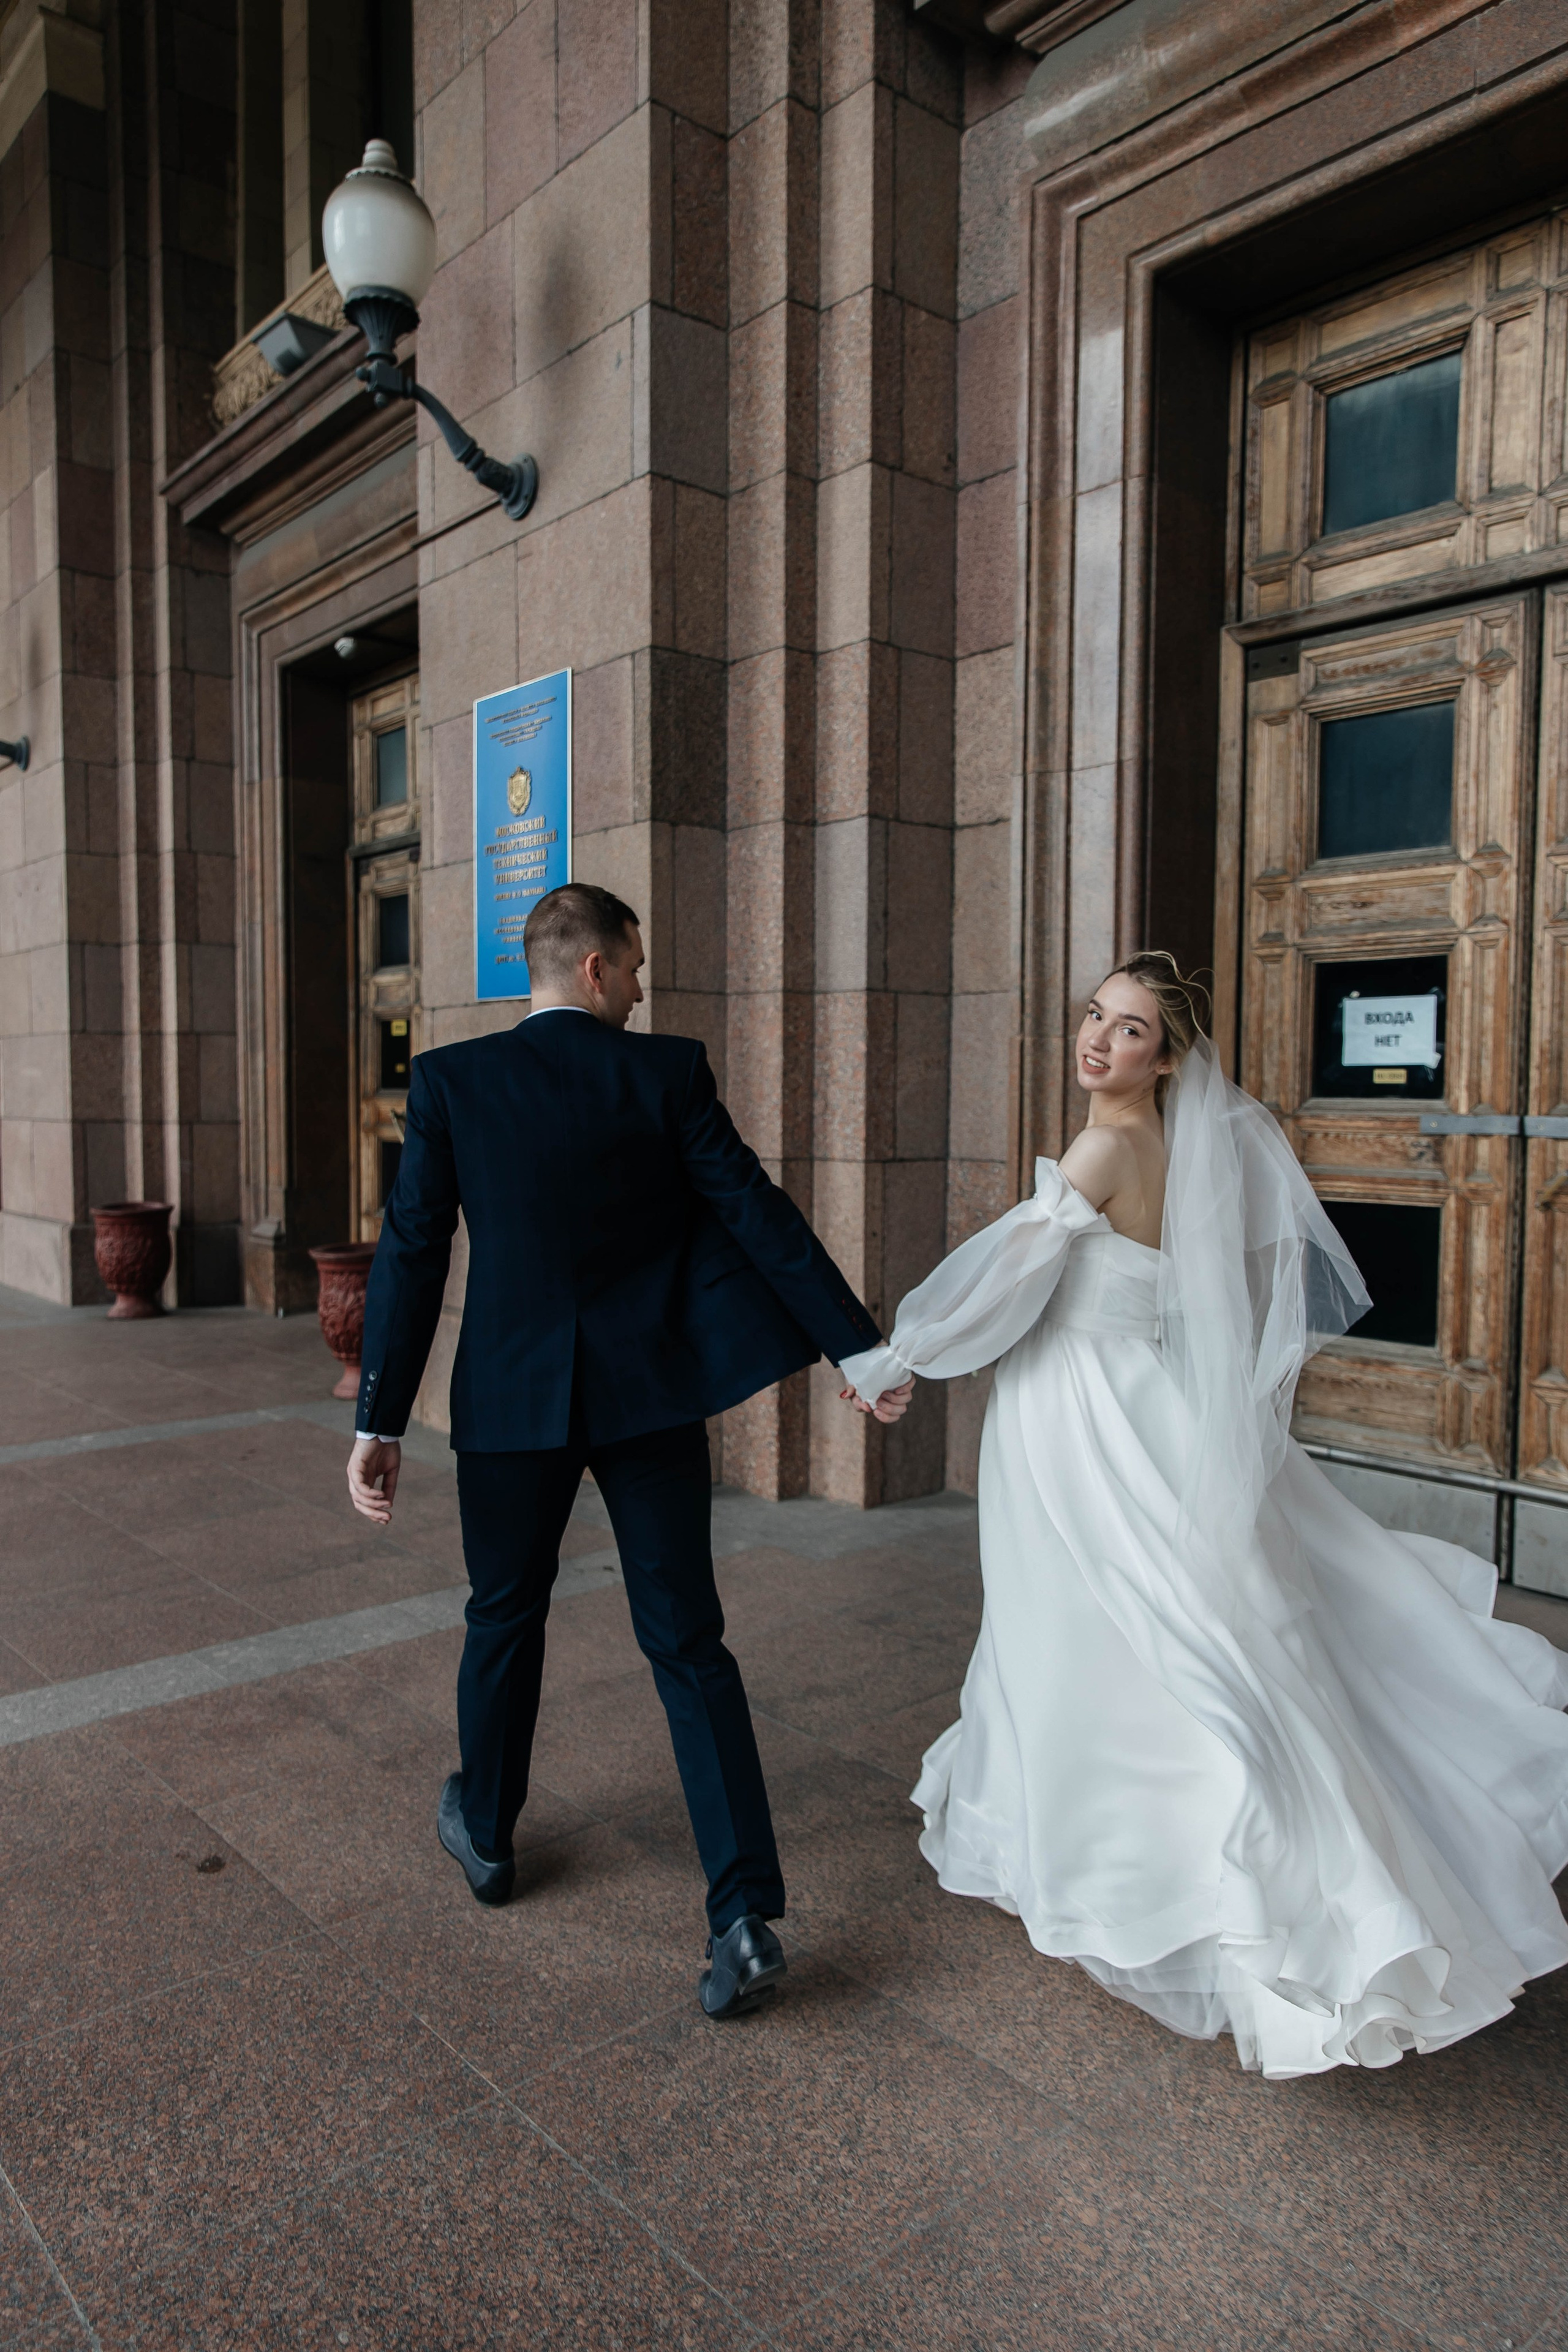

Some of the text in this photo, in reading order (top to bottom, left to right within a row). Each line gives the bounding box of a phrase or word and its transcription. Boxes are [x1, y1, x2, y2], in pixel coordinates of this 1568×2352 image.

[496, 815, 545, 837] МОСКОВСКИЙ
[484, 829, 557, 855] ГОСУДАРСТВЕННЫЙ
[493, 848, 547, 869] ТЕХНИЧЕСКИЙ
[494, 865, 546, 884] УНИВЕРСИТЕТ
[1365, 1011, 1415, 1027] ВХОДА
[1374, 1034, 1402, 1047] НЕТ
